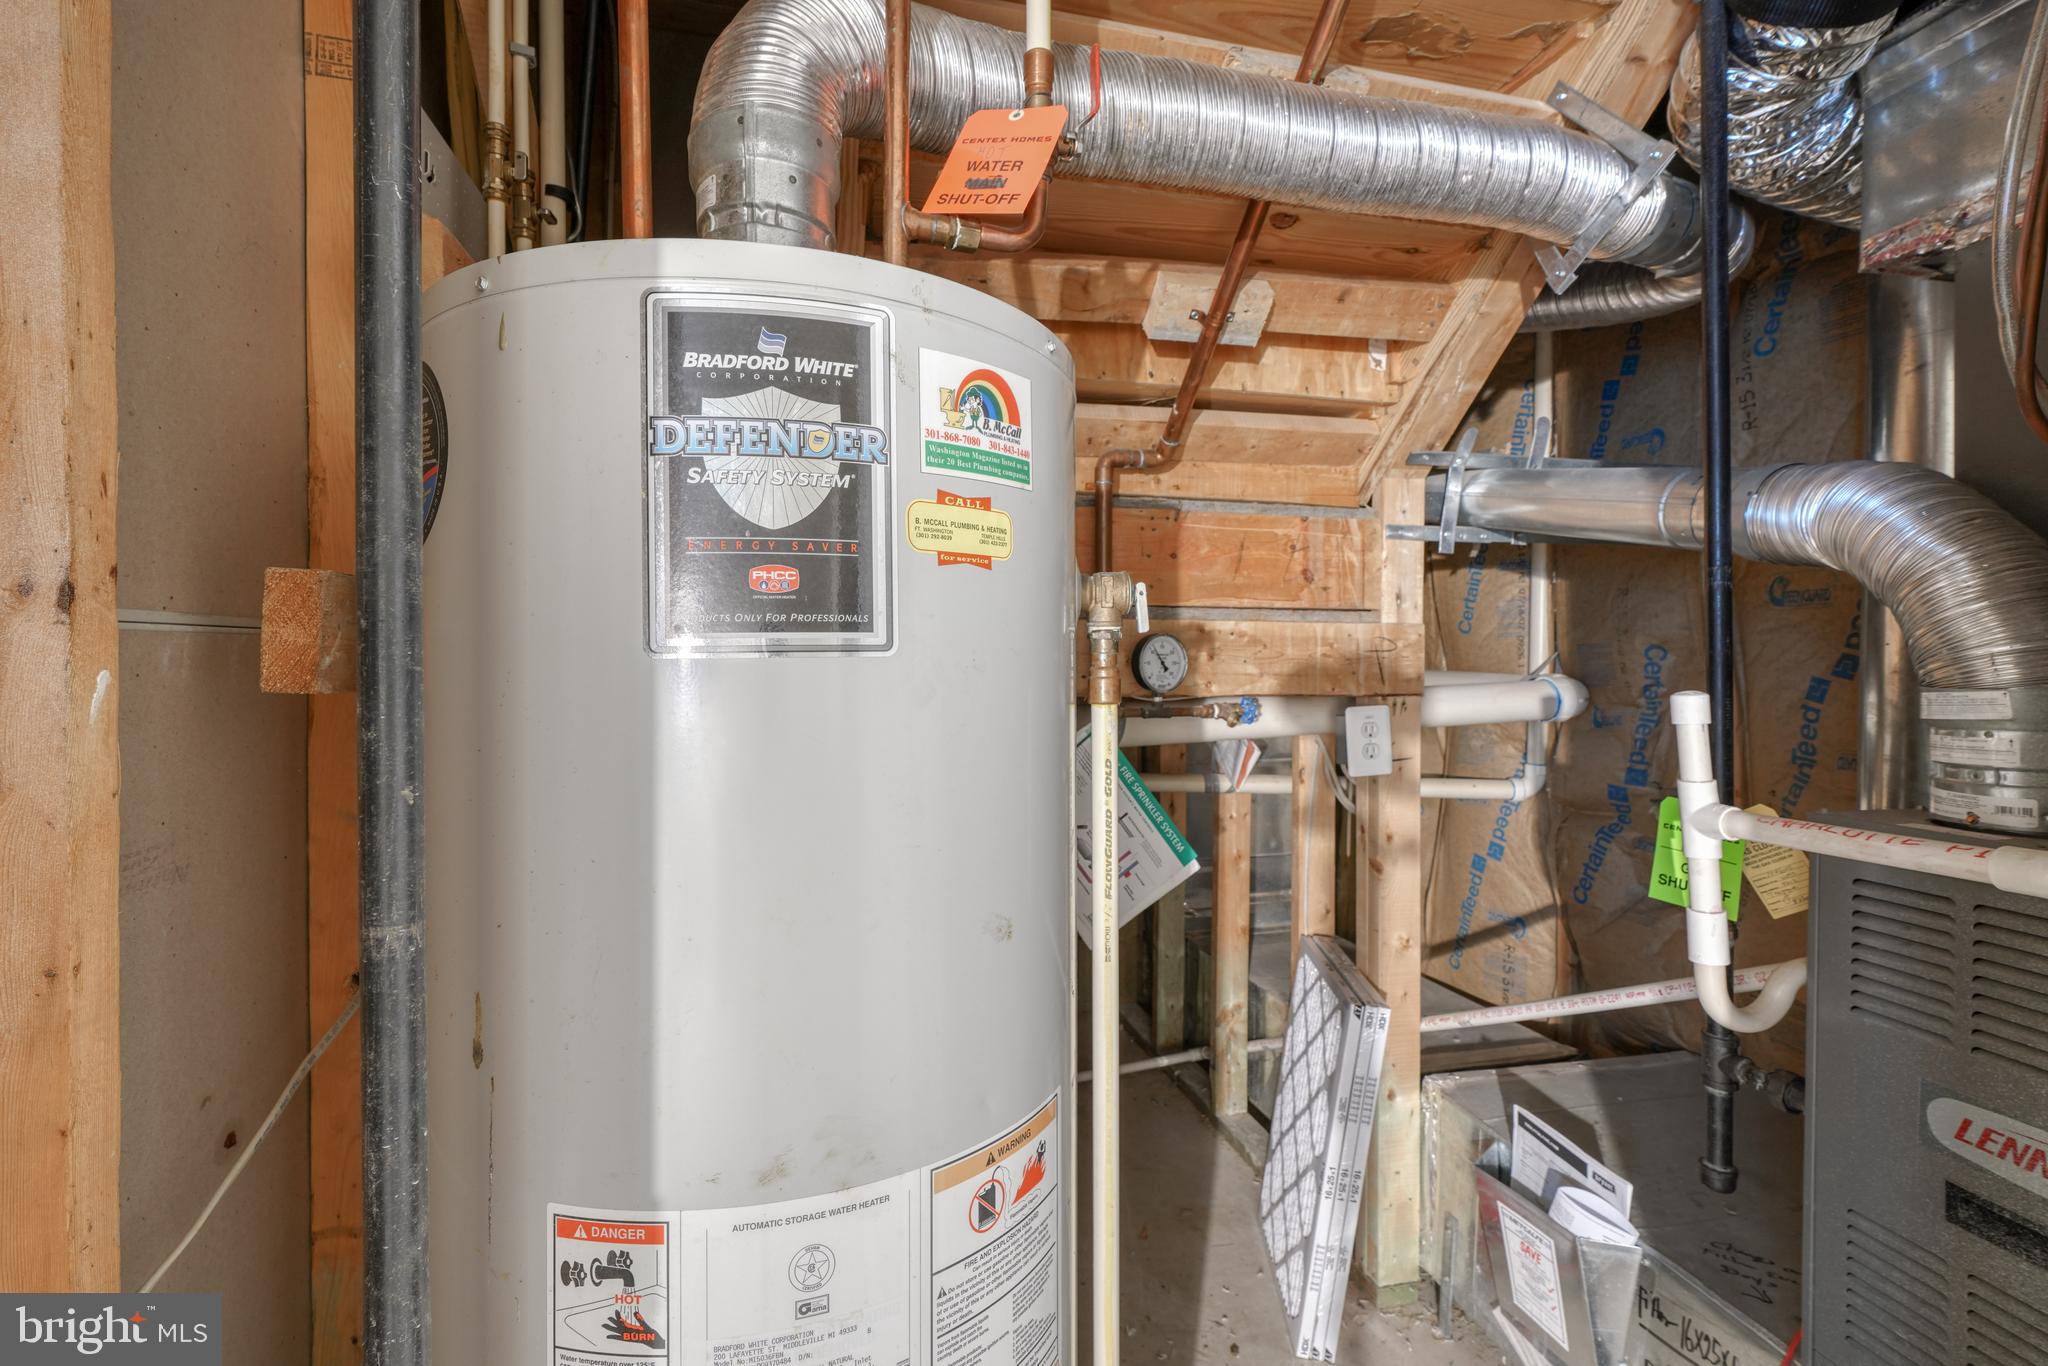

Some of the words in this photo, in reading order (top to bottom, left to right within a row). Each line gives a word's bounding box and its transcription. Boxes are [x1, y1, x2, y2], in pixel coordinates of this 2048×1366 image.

[967, 160, 1024, 172] WATER
[937, 193, 1022, 205] SHUT-OFF
[682, 351, 790, 373] BRADFORD
[696, 371, 842, 387] CORPORATION
[924, 428, 982, 448] 301-868-7080
[983, 419, 992, 431] B.
[993, 422, 1022, 440] McCall
[649, 415, 889, 466] DEFENDER
[928, 443, 970, 459] Washington
[972, 450, 1001, 465] Magazine
[927, 454, 945, 466] their
[946, 457, 955, 466] 20
[957, 460, 971, 471] Best
[972, 461, 1001, 477] Plumbing
[687, 467, 768, 486] SAFETY
[945, 496, 984, 511] CALL
[915, 518, 922, 526] B.
[923, 518, 948, 528] MCCALL
[950, 520, 980, 531] PLUMBING
[986, 526, 1008, 536] HEATING
[923, 527, 954, 535] WASHINGTON
[687, 540, 777, 552] ENERGY
[792, 541, 859, 554] SAVER
[940, 554, 953, 563] for
[954, 555, 990, 566] service
[752, 570, 798, 582] PHCC
[734, 613, 762, 624] ONLY
[765, 613, 787, 623] FOR
[790, 613, 870, 624] PROFESSIONALS
[1105, 757, 1113, 798] GOLD
[1119, 765, 1135, 784] FIRE
[1131, 779, 1165, 825] SPRINKLER
[1159, 819, 1186, 853] SYSTEM
[1105, 808, 1113, 899] FLOWGUARD
[997, 1128, 1032, 1157] WARNING
[732, 1217, 783, 1233] AUTOMATIC
[785, 1210, 827, 1227] STORAGE
[828, 1204, 858, 1219] WATER
[858, 1194, 891, 1212] HEATER
[591, 1226, 646, 1241] DANGER
[964, 1256, 977, 1269] FIRE
[979, 1247, 991, 1261] AND
[993, 1225, 1018, 1253] EXPLOSION
[614, 1294, 642, 1306] HOT
[623, 1332, 656, 1342] BURN
[713, 1342, 745, 1353] BRADFORD
[748, 1340, 768, 1349] WHITE
[771, 1330, 815, 1345] CORPORATION
[713, 1352, 727, 1361] 200
[730, 1348, 764, 1359] LAFAYETTE
[782, 1334, 825, 1350] MIDDLEVILLE
[828, 1332, 836, 1340] MI
[838, 1325, 858, 1336] 49333
[560, 1352, 577, 1363] Water
[579, 1355, 618, 1366] temperature
